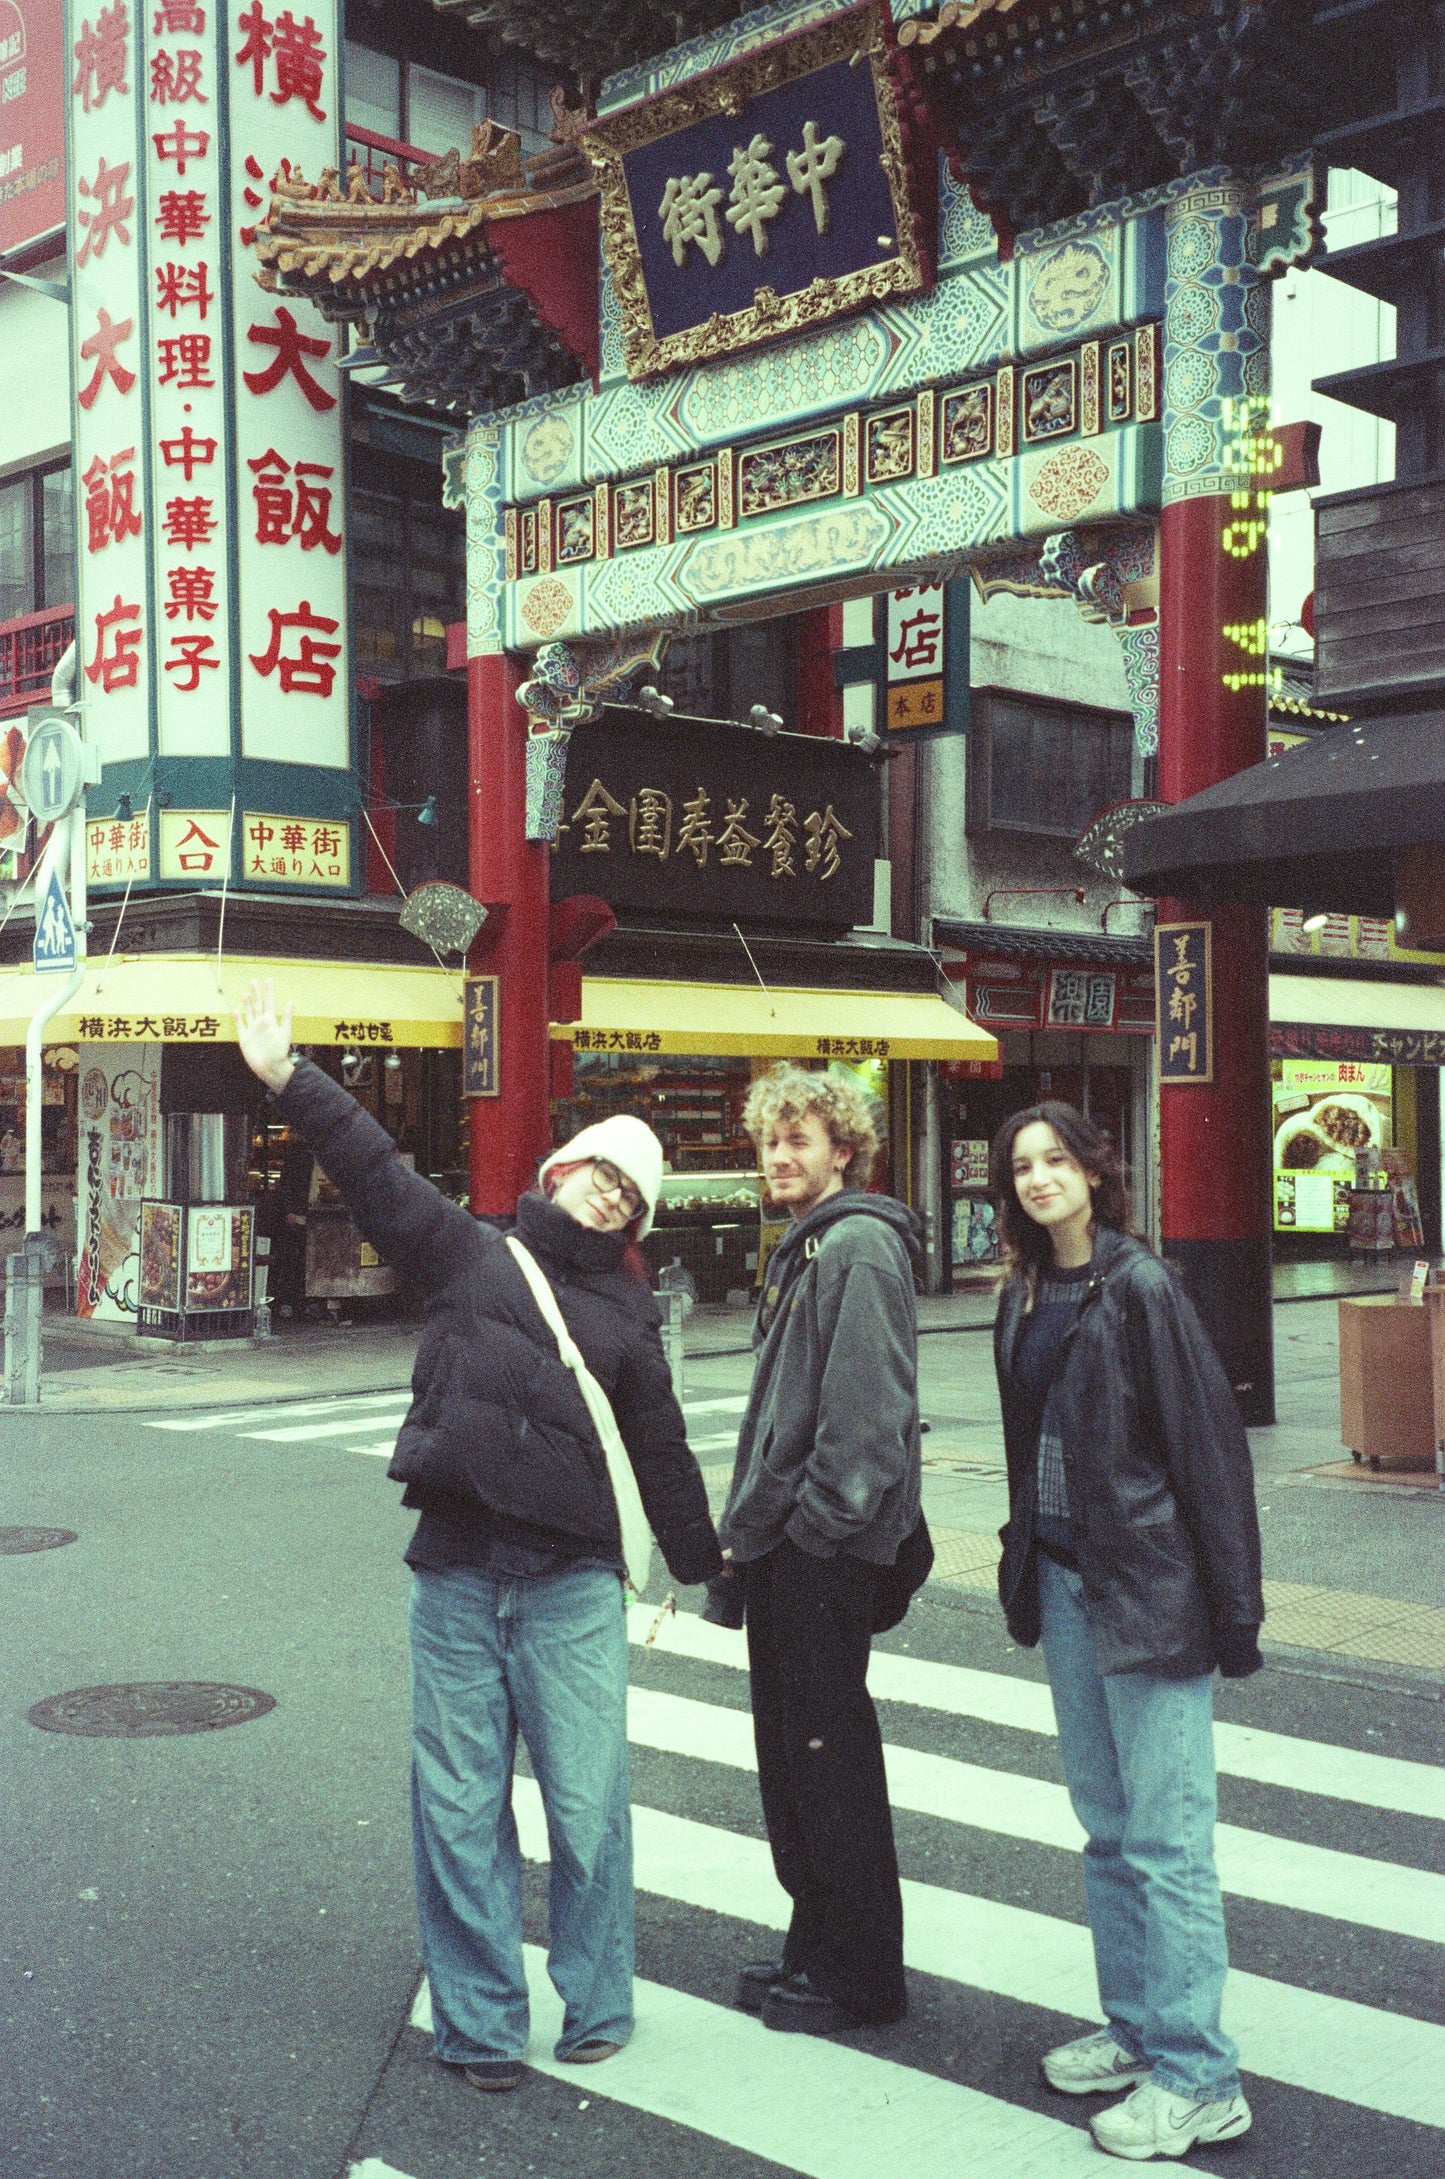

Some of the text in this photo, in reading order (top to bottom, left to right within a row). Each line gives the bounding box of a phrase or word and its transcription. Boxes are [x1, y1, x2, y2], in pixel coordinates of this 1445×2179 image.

[895, 691, 937, 717] 本店
[90, 822, 148, 852] 中華街
[175, 819, 220, 871] 入口
[250, 821, 342, 858] 中華街
[90, 857, 148, 878] 大通り入口
[250, 854, 341, 877] 大通り入口
[79, 1016, 220, 1039] 横浜大飯店
[334, 1020, 394, 1042] 大粒甘栗
[574, 1030, 662, 1051] 横浜大飯店
[817, 1038, 890, 1056] 横浜大飯店
[1338, 1064, 1366, 1084] 肉まん
